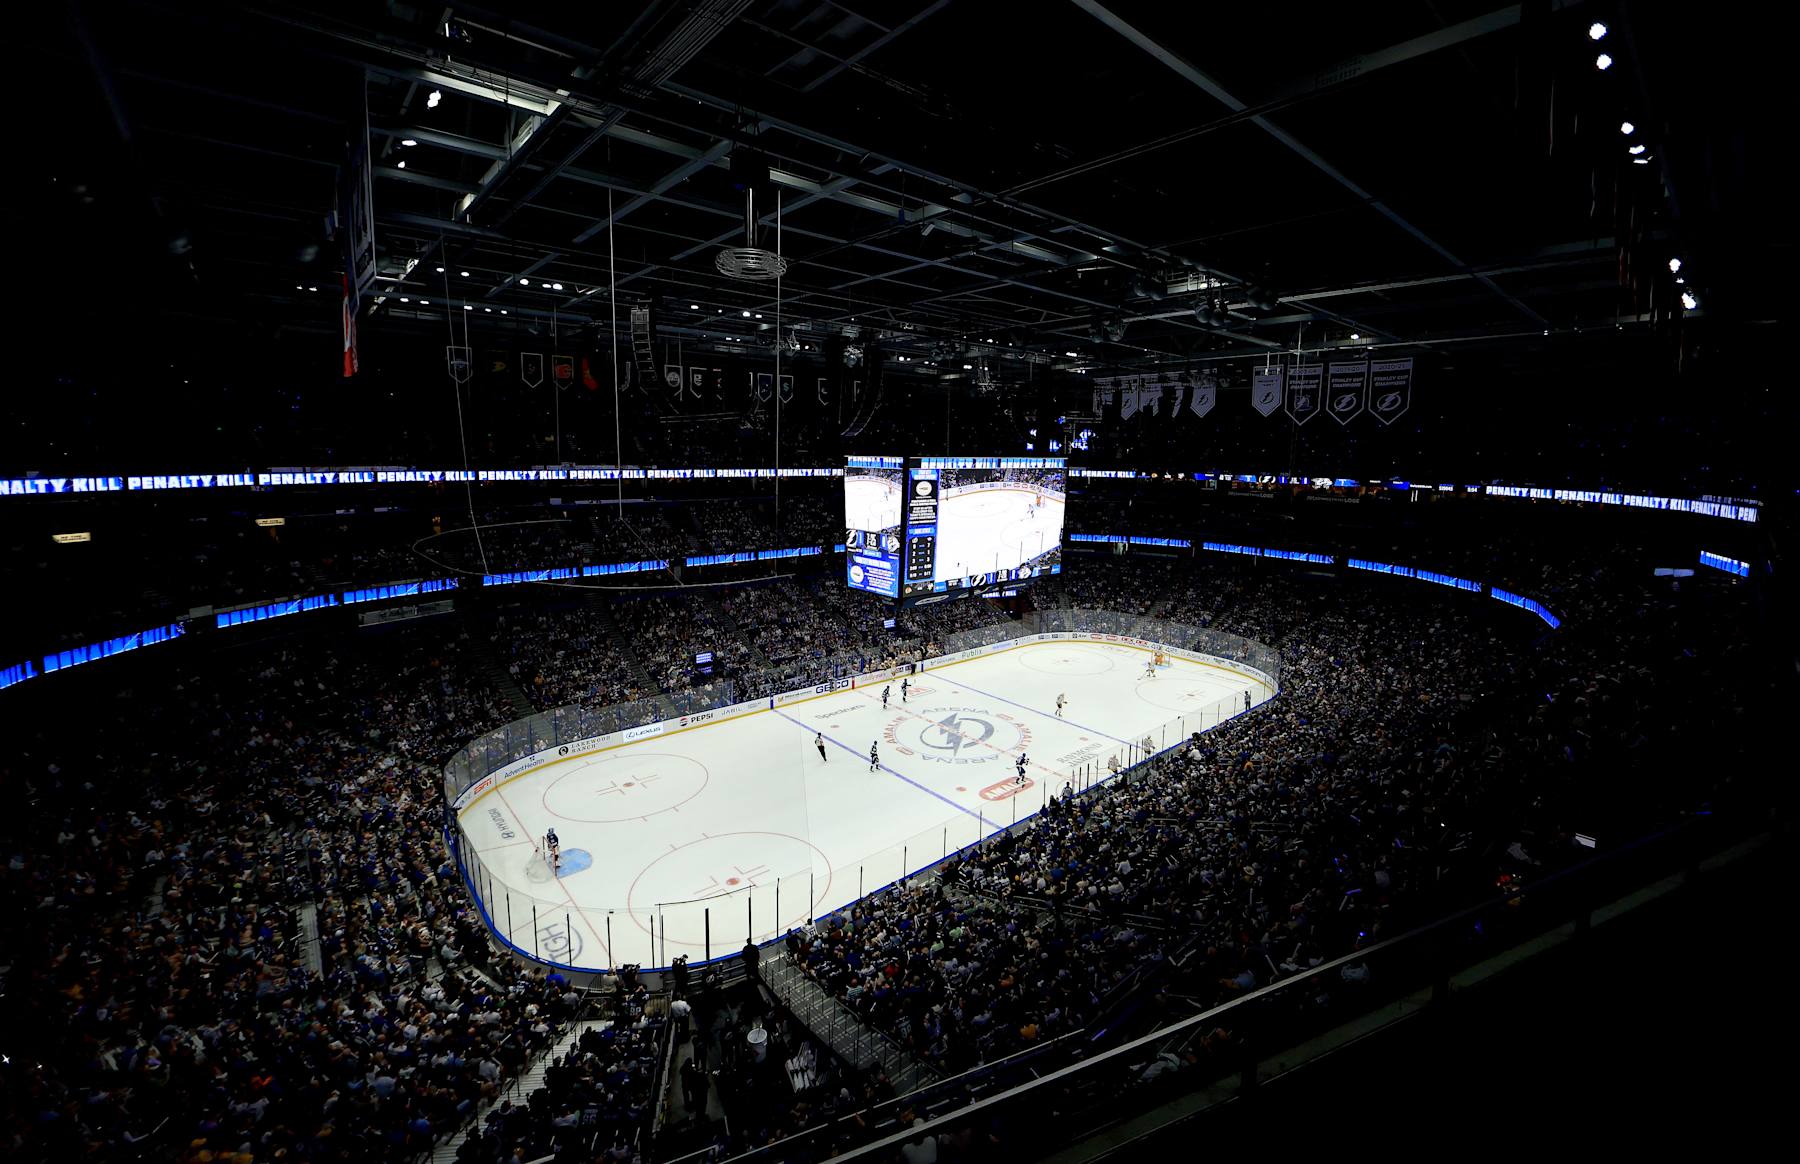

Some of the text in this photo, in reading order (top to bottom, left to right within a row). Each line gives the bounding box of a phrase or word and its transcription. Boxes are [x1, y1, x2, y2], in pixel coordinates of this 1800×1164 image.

[72, 477, 122, 492] KILL
[127, 475, 213, 490] PENALTY
[216, 474, 254, 487] KILL
[258, 472, 337, 485] PENALTY
[339, 472, 374, 483] KILL
[377, 471, 442, 482] PENALTY
[445, 471, 475, 481] KILL
[478, 471, 537, 481] PENALTY
[539, 470, 566, 480] KILL
[569, 470, 620, 480] PENALTY
[622, 470, 645, 479] KILL
[647, 470, 692, 479] PENALTY
[693, 469, 715, 478] KILL
[716, 469, 757, 478] PENALTY
[758, 469, 776, 477] KILL
[777, 469, 813, 477] PENALTY
[814, 469, 831, 477] KILL
[1081, 470, 1116, 478] PENALTY
[1486, 486, 1529, 497] PENALTY
[1530, 487, 1552, 499] KILL
[1554, 489, 1601, 502] PENALTY
[1601, 492, 1623, 505] KILL
[1623, 494, 1669, 509] PENALTY
[1669, 498, 1690, 512] KILL
[1690, 500, 1720, 516] PENALTY
[1720, 505, 1737, 519] KILL
[816, 680, 849, 694] GECO
[691, 712, 714, 723] PEPSI
[571, 735, 611, 748] LAKEWOOD
[572, 744, 596, 753] RANCH
[504, 758, 545, 779] AdventHealth
